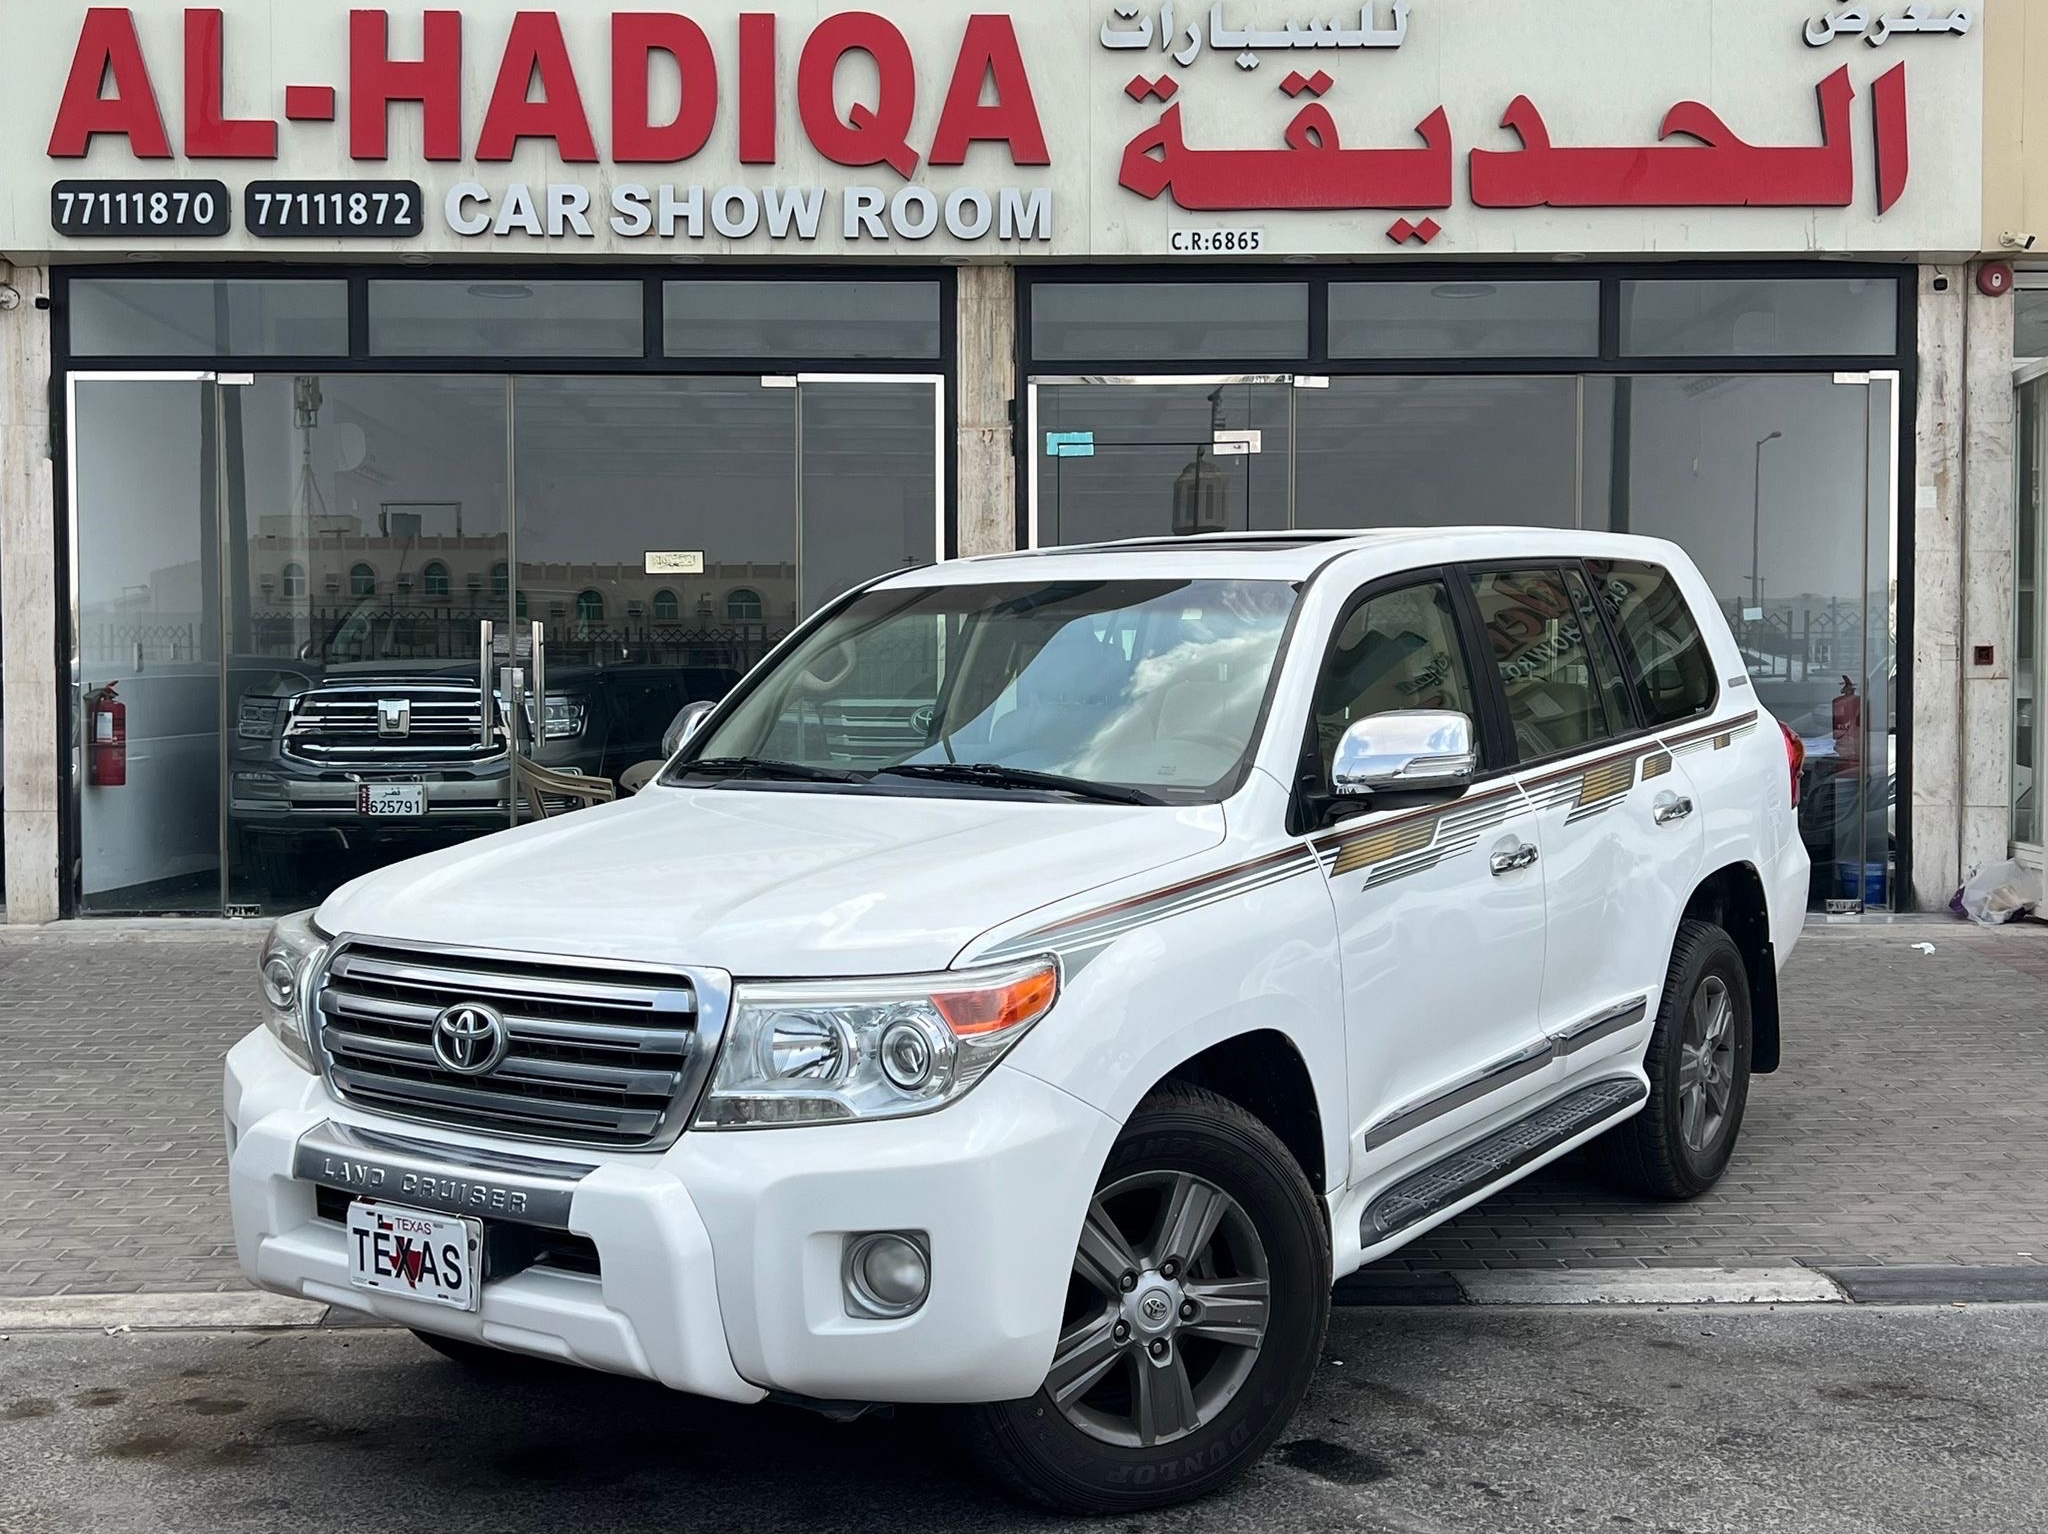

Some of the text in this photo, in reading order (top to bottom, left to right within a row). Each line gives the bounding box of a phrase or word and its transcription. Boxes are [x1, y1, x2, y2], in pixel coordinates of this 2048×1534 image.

[1100, 0, 1411, 70] للسيارات
[47, 7, 1051, 181] AL-HADIQA
[1118, 60, 1909, 245] الحديقة
[57, 192, 214, 225] 77111870
[254, 192, 412, 226] 77111872
[445, 182, 1052, 241] CAR SHOW ROOM
[1171, 231, 1261, 252] C.R:6865
[370, 800, 420, 814] 625791
[322, 1157, 528, 1214] LAND CRUISER
[395, 1217, 432, 1235] TEXAS
[352, 1227, 462, 1290] TEXAS
[1105, 1417, 1251, 1486] DUNLOP
